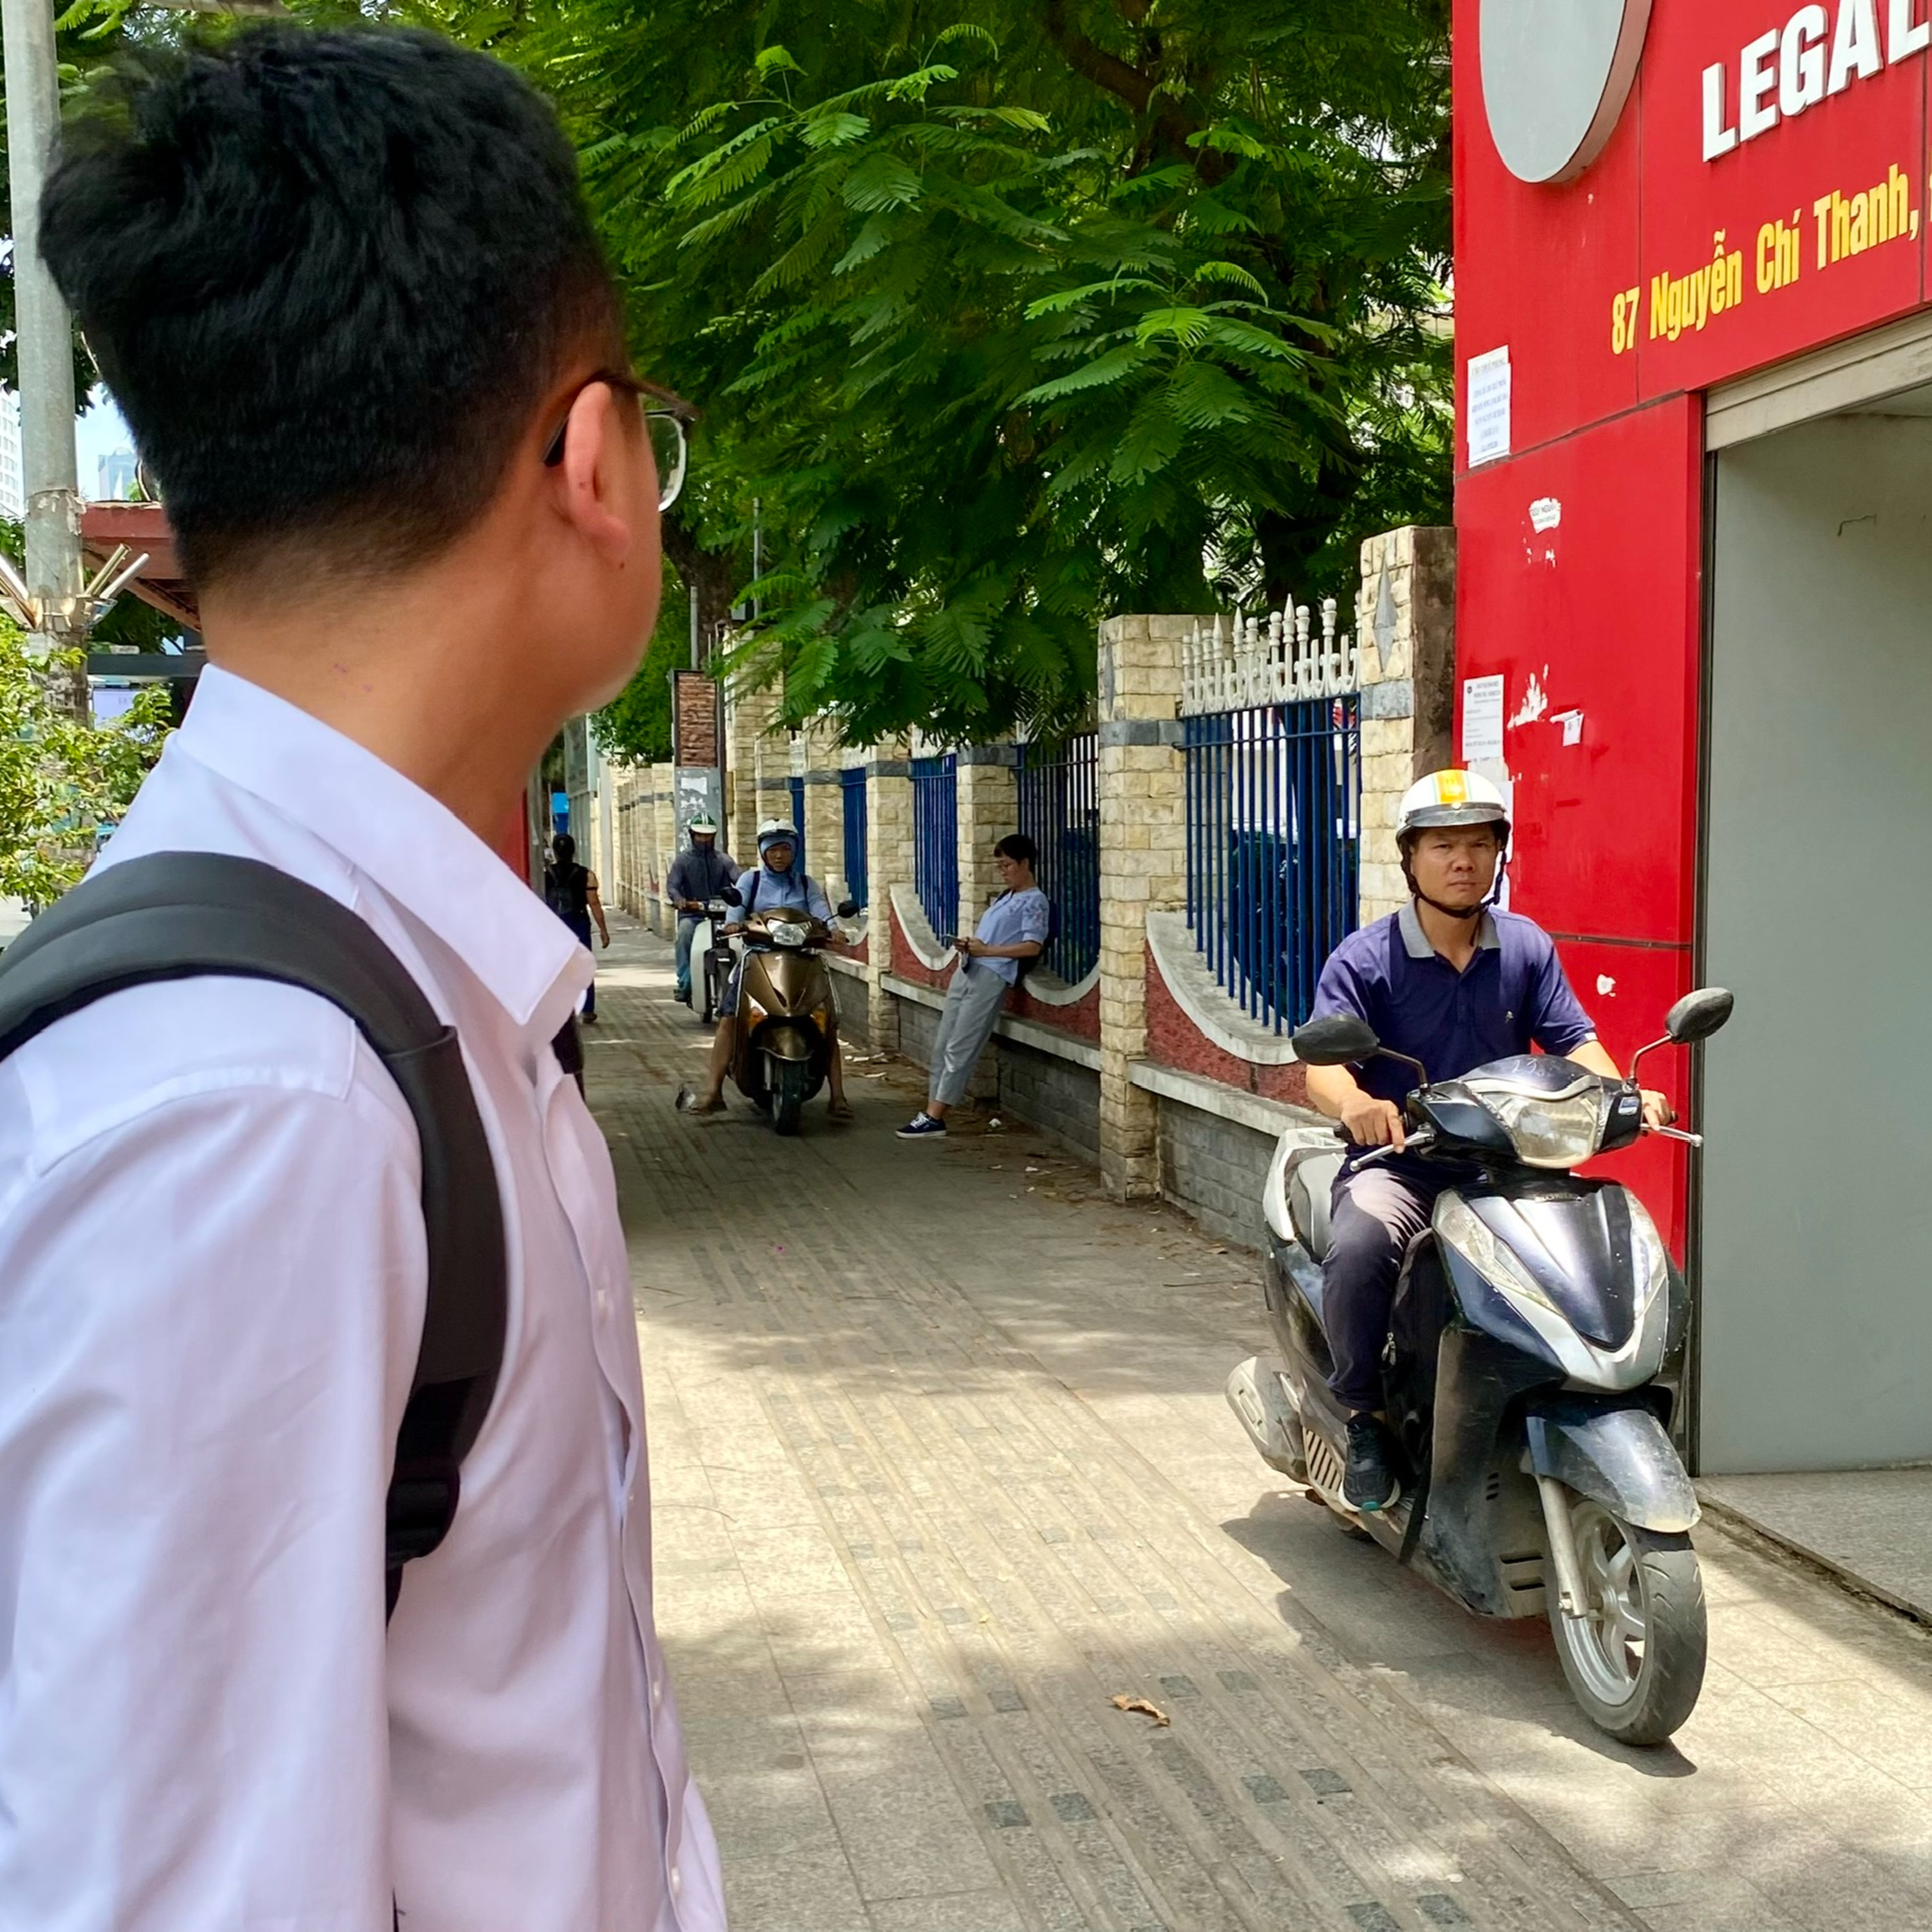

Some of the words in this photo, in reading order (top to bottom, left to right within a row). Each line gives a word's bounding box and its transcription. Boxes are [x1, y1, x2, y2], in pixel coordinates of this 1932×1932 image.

[1702, 0, 1931, 162] LEGAL
[1611, 286, 1640, 355] 87
[1650, 227, 1743, 341] Nguyễn
[1756, 208, 1801, 294] Chí
[1814, 163, 1919, 270] Thanh,
